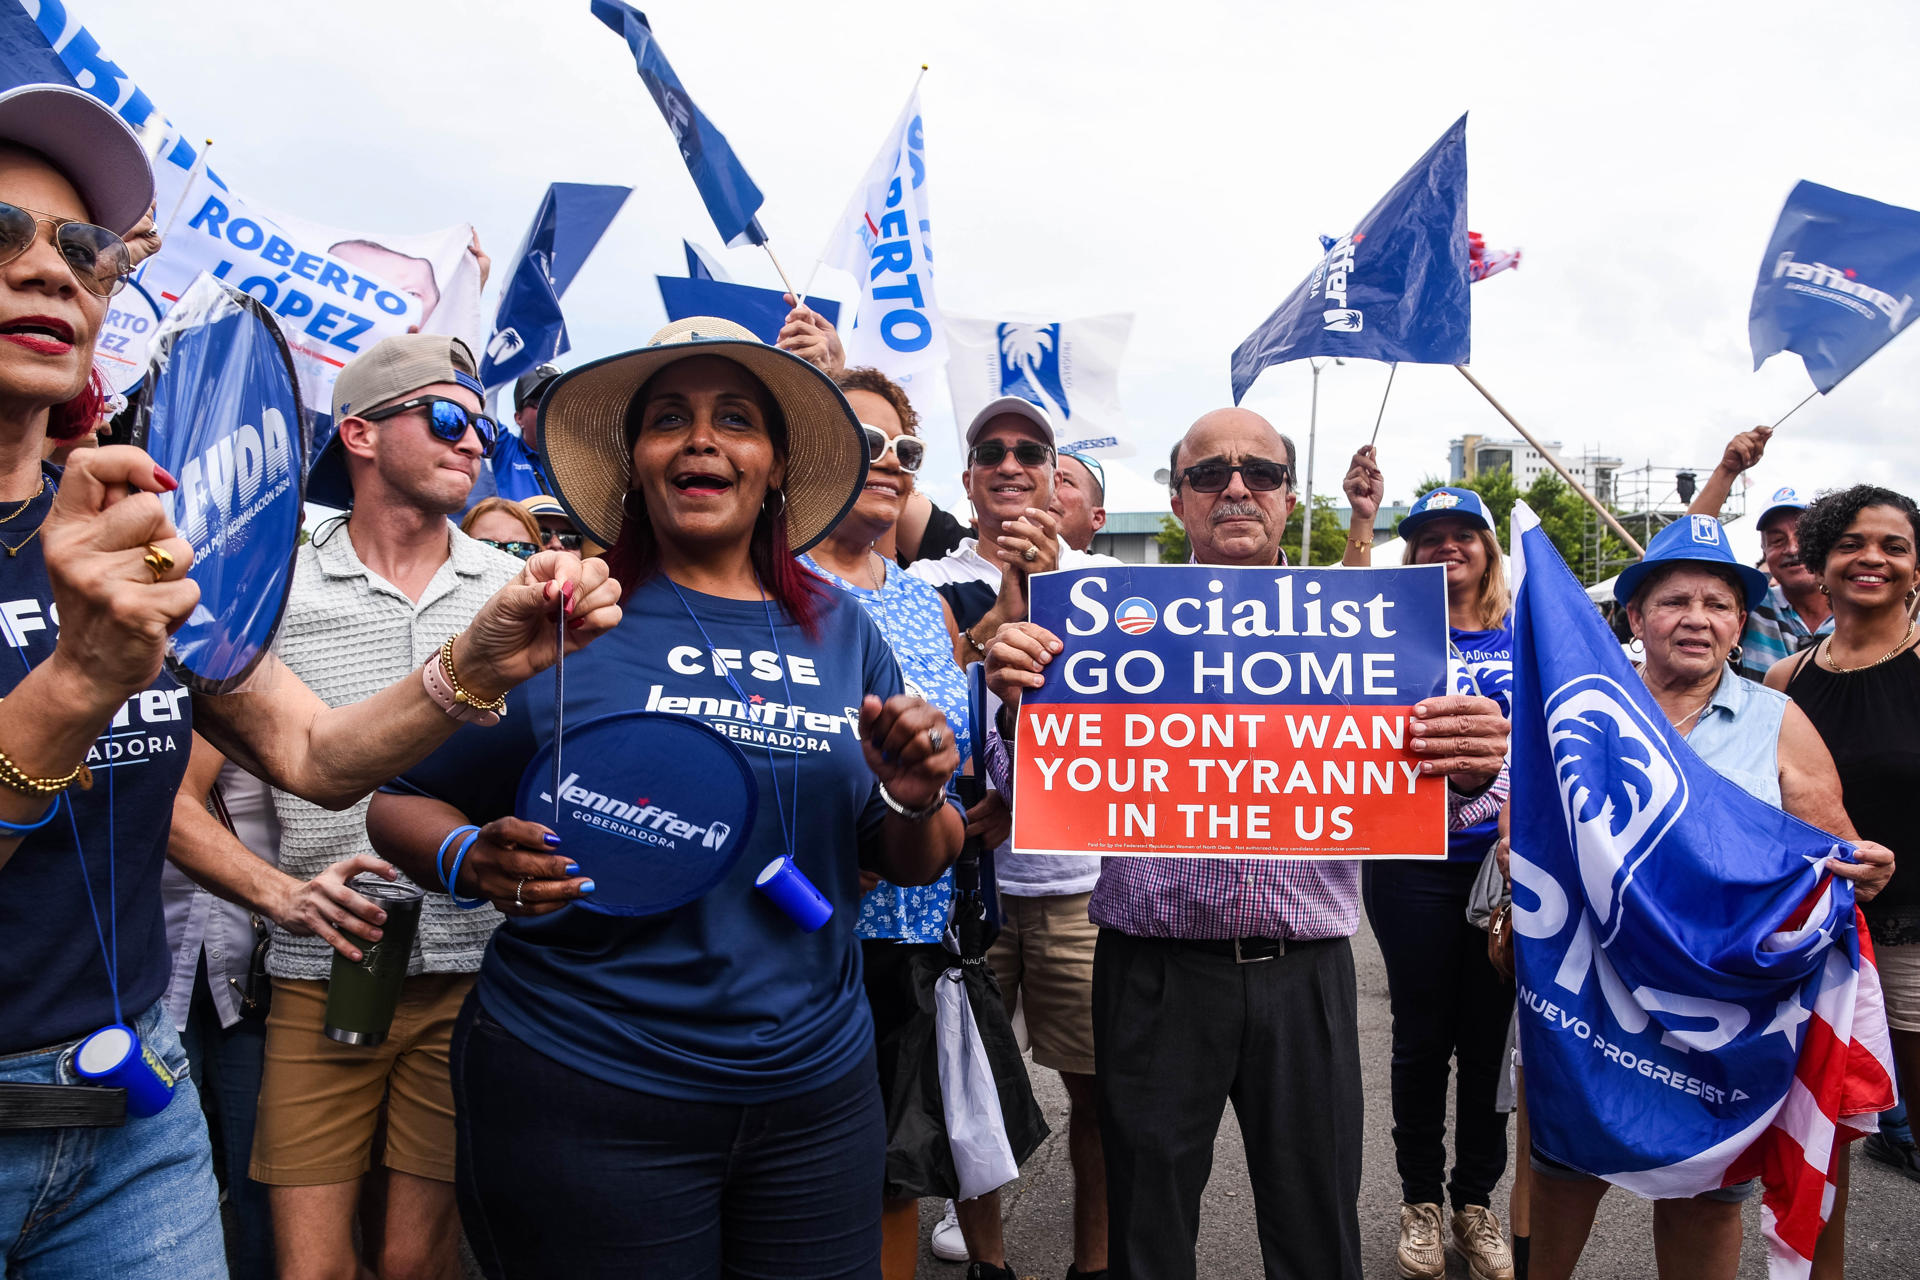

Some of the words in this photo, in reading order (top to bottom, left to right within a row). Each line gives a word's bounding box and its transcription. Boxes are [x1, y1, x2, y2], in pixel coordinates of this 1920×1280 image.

[188, 195, 407, 315] ROBERTO
[667, 645, 820, 686] CFSE
[1064, 650, 1165, 695] GO
[1193, 650, 1398, 696] HOME
[1030, 713, 1102, 747] WE
[1125, 713, 1266, 748] DONT
[1285, 714, 1417, 750] WAN
[1034, 757, 1169, 792] YOUR
[1189, 759, 1423, 795] TYRANNY
[540, 772, 706, 840] Jenniffer
[1108, 803, 1156, 837] IN
[1177, 804, 1271, 840] THE
[1295, 805, 1354, 841] US
[572, 810, 676, 850] GOBERNADORA
[1519, 985, 1591, 1040] NUEVO
